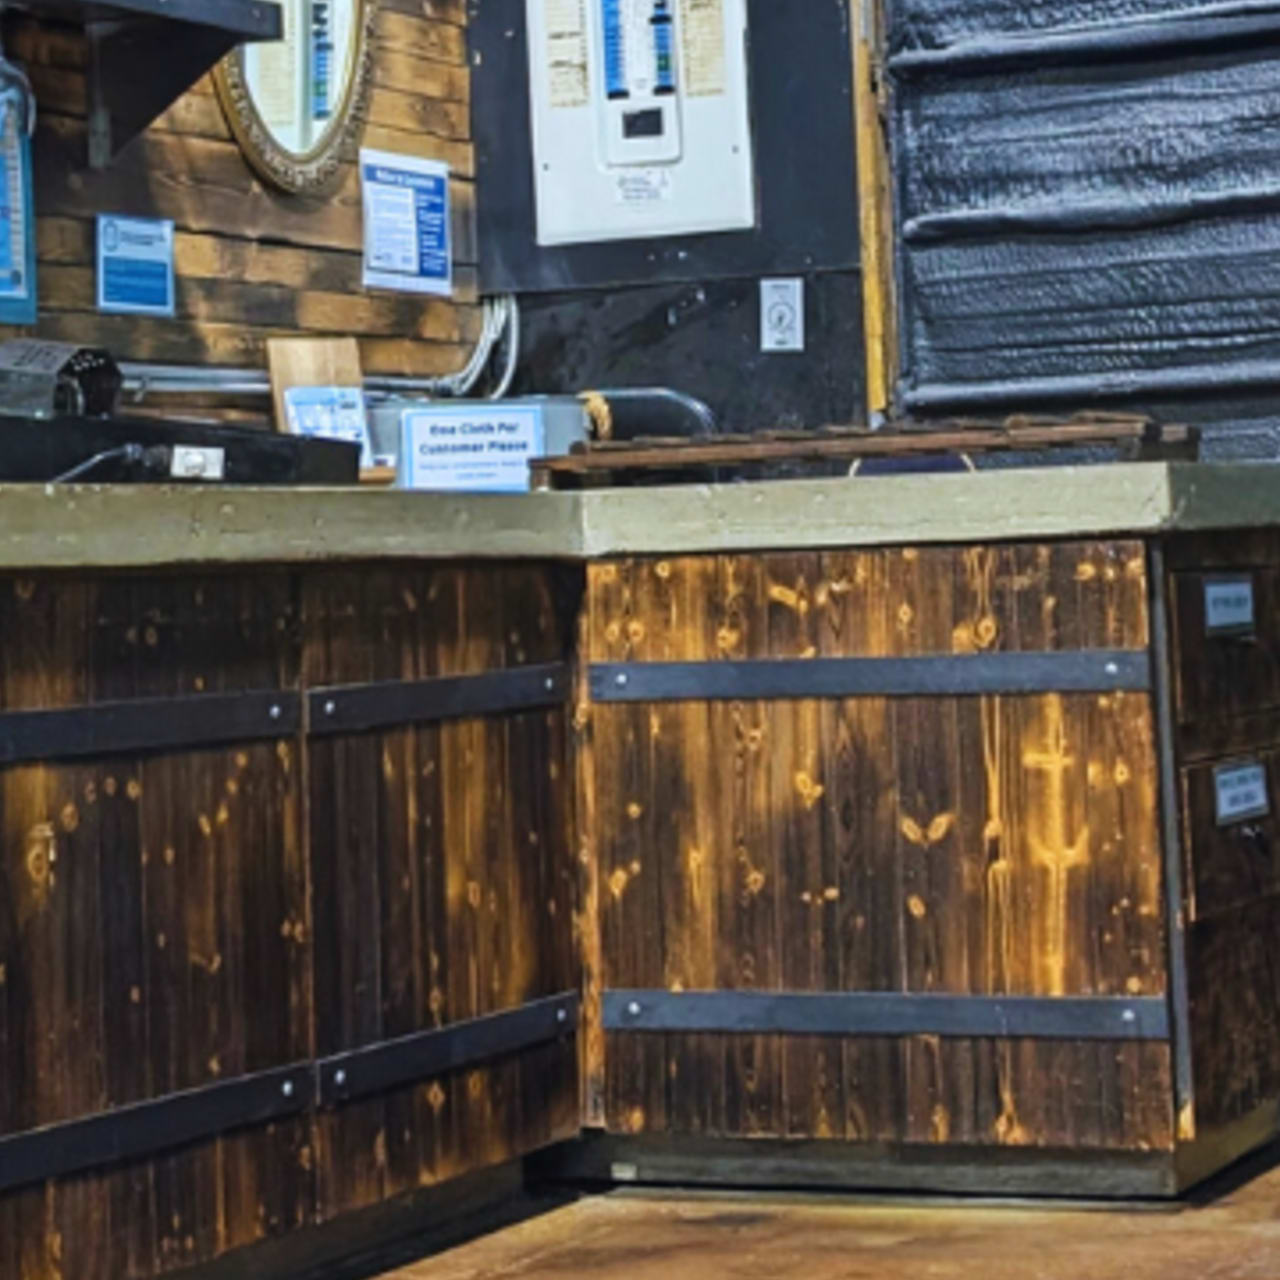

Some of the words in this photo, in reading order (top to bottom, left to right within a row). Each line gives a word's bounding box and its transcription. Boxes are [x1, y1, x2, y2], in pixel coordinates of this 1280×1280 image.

[459, 422, 495, 435] Cloth
[419, 444, 484, 455] Customer
[487, 441, 528, 452] Please
